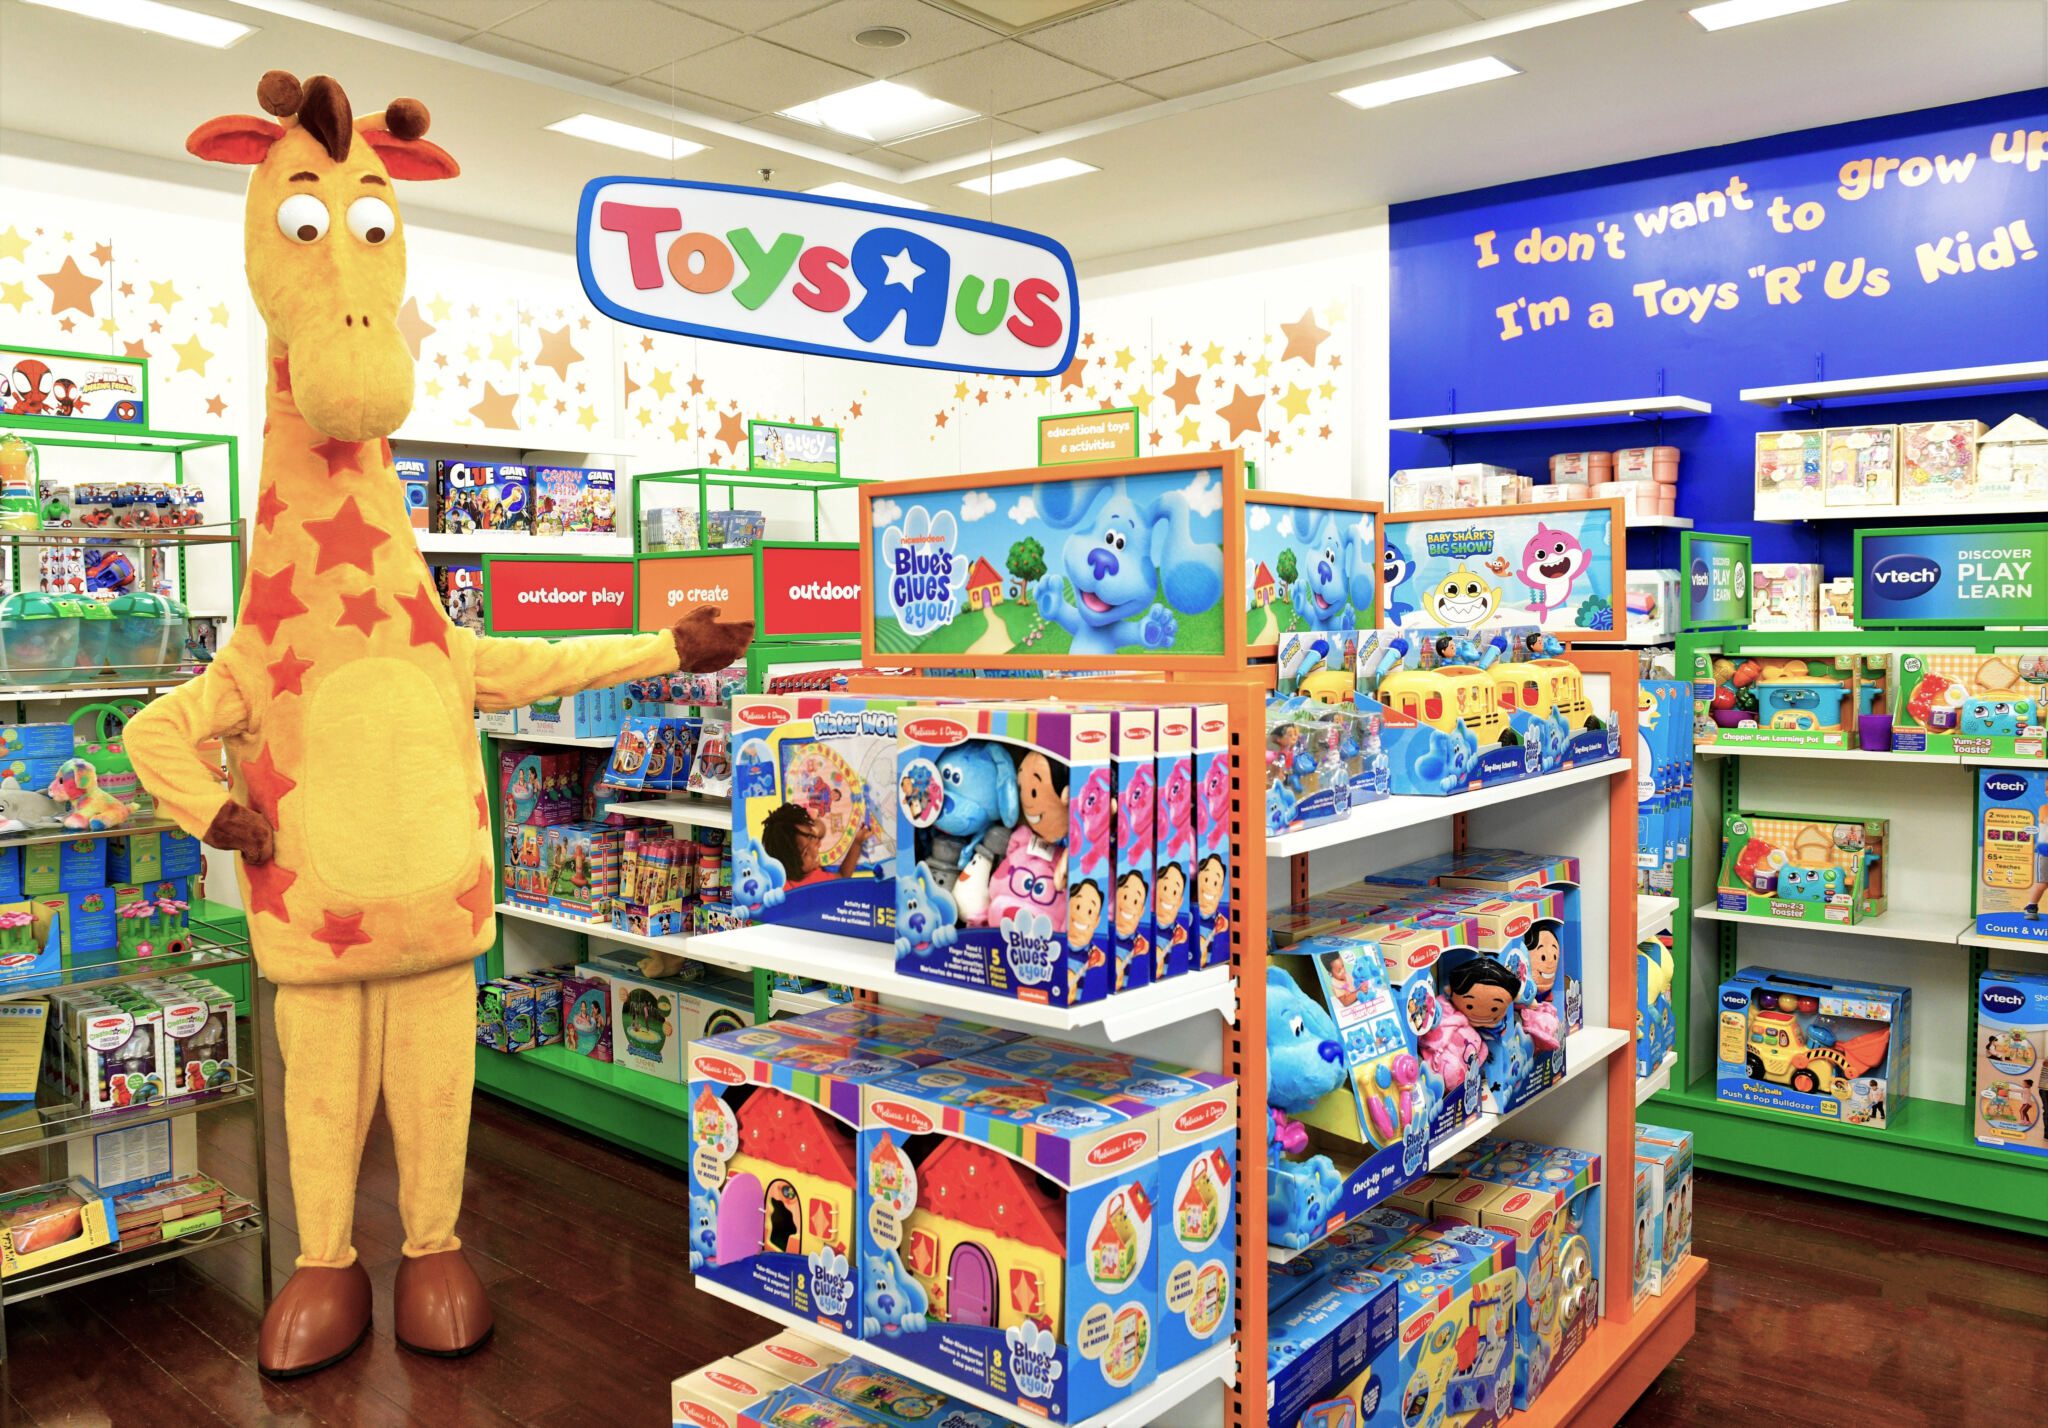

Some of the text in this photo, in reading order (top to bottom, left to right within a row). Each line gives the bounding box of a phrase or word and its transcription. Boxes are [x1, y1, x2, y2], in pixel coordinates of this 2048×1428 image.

[1474, 230, 1499, 268] I
[1514, 222, 1625, 264] don't
[1635, 175, 1754, 237] want
[1767, 196, 1825, 233] to
[1837, 151, 1977, 201] grow
[1495, 220, 2038, 340] I'm a Toys "R" Us Kid!
[1047, 421, 1130, 438] educational toys
[1069, 438, 1116, 453] activities
[395, 461, 424, 472] GIANT
[500, 466, 527, 477] GIANT
[450, 463, 494, 488] CLUE
[542, 469, 582, 484] CANDY
[587, 471, 614, 482] GIANT
[547, 482, 578, 496] LAND
[1427, 528, 1494, 543] BABY SHARK'S
[1428, 541, 1492, 554] BIG SHOW!
[1958, 549, 2032, 560] DISCOVER
[894, 545, 953, 575] Blue's
[455, 568, 483, 588] CLU
[1713, 569, 1730, 585] PLAY
[1958, 561, 2032, 581] PLAY
[518, 587, 625, 606] outdoor play
[667, 584, 729, 607] go create
[789, 580, 861, 600] outdoor
[1713, 589, 1730, 601] LEARN
[1958, 584, 2032, 599] LEARN
[815, 714, 860, 737] Water
[909, 725, 937, 736] Melissa
[1772, 735, 1805, 745] Learning
[1952, 737, 1992, 746] Yum-2-3
[1954, 745, 1991, 754] Toaster
[1986, 781, 2024, 792] vtech
[1770, 900, 1805, 910] Yum-2-3
[1771, 907, 1804, 918] Toaster
[877, 907, 885, 925] 5
[1985, 923, 2048, 937] Count & Wi
[1010, 931, 1050, 951] Blue's
[991, 948, 1000, 965] 5
[1723, 995, 1747, 1004] vtech
[1984, 993, 2022, 1005] vtech
[2034, 994, 2048, 1002] Sho
[698, 1057, 721, 1073] Melissa
[1722, 1089, 1743, 1099] Push
[1753, 1095, 1770, 1105] Pop
[1773, 1097, 1814, 1111] Bulldozer
[876, 1104, 904, 1122] Melissa
[1180, 1115, 1204, 1130] Melissa
[700, 1153, 717, 1163] WOODEN
[1093, 1145, 1121, 1162] Melissa
[1353, 1164, 1395, 1195] Check-Up Time
[1366, 1185, 1380, 1200] Blue
[876, 1209, 894, 1222] WOODEN
[797, 1274, 805, 1290] 8
[814, 1264, 845, 1289] Blue's
[1173, 1270, 1192, 1281] WOODEN
[1087, 1313, 1107, 1325] WOODEN
[1090, 1333, 1110, 1346] MADERA
[993, 1349, 1002, 1368] 8
[1014, 1340, 1051, 1369] Blue's
